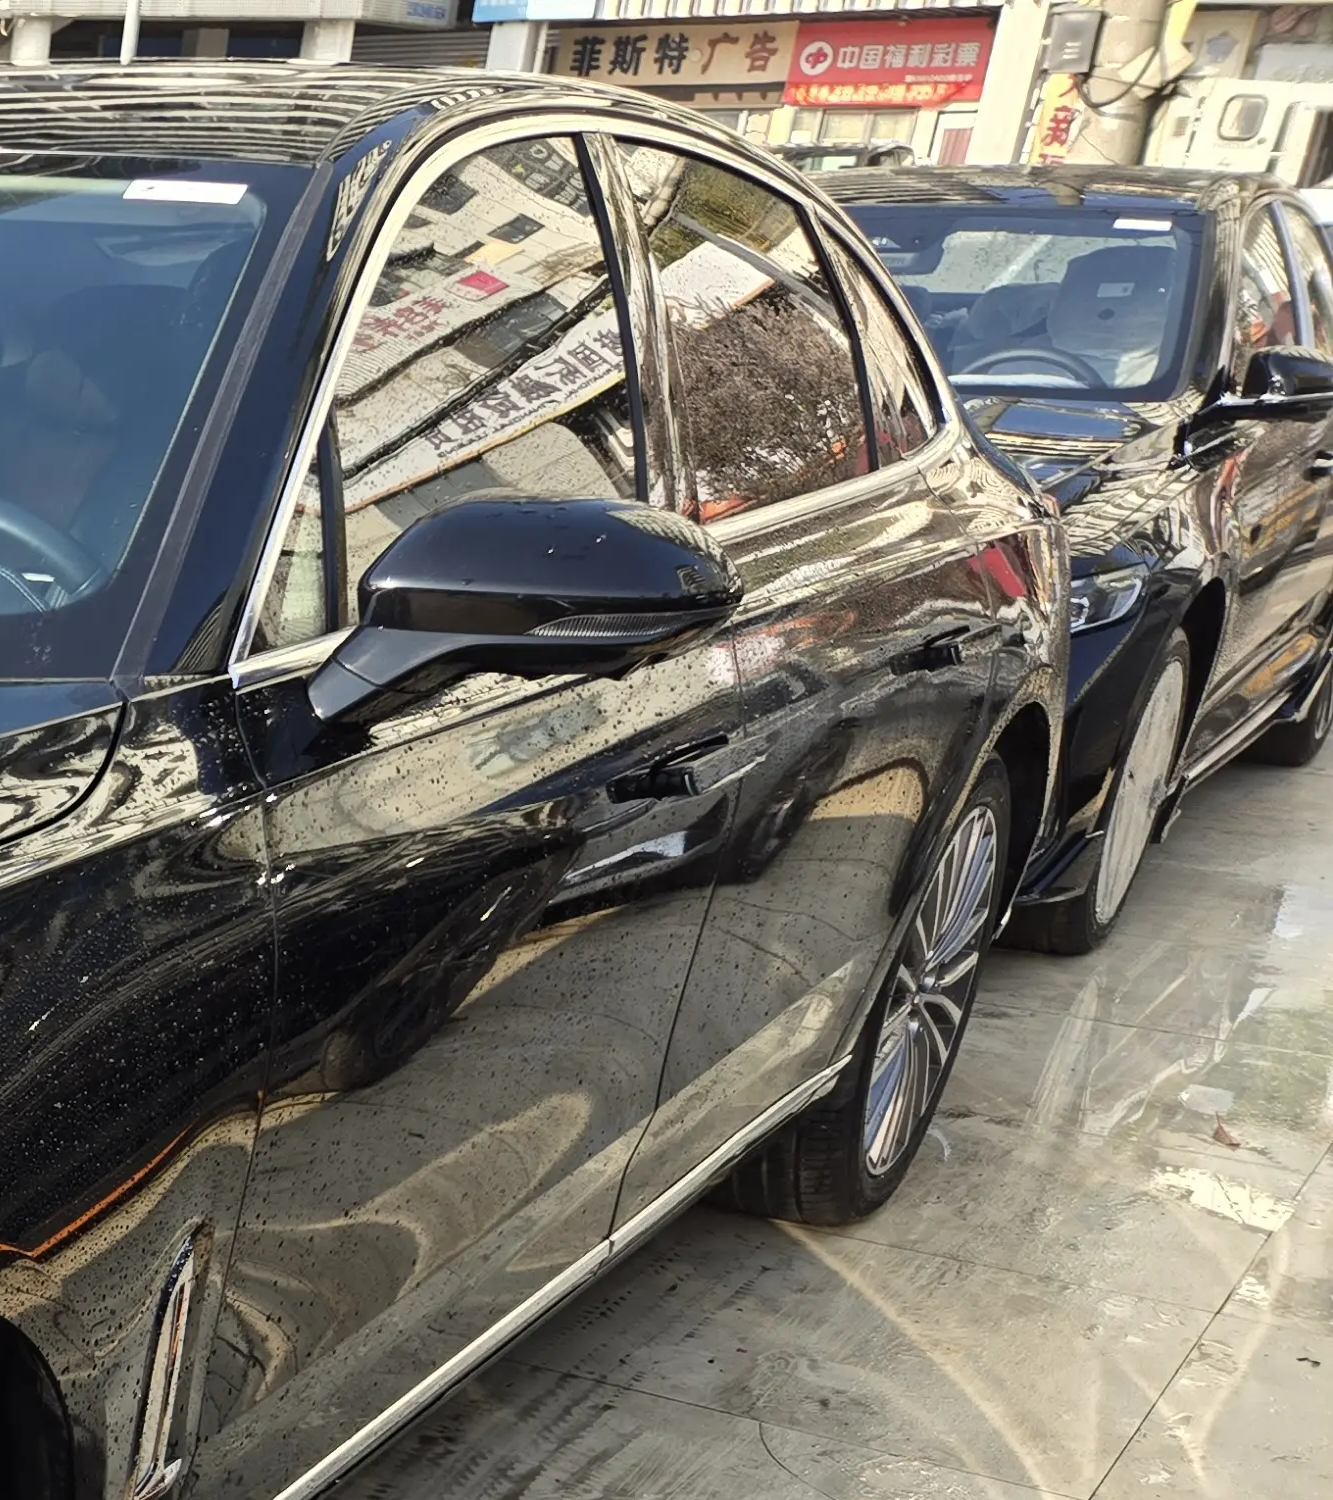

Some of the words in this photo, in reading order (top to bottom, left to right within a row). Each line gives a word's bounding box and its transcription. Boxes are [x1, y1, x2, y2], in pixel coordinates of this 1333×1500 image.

[569, 31, 780, 77] 菲斯特广告
[836, 41, 982, 70] 中国福利彩票
